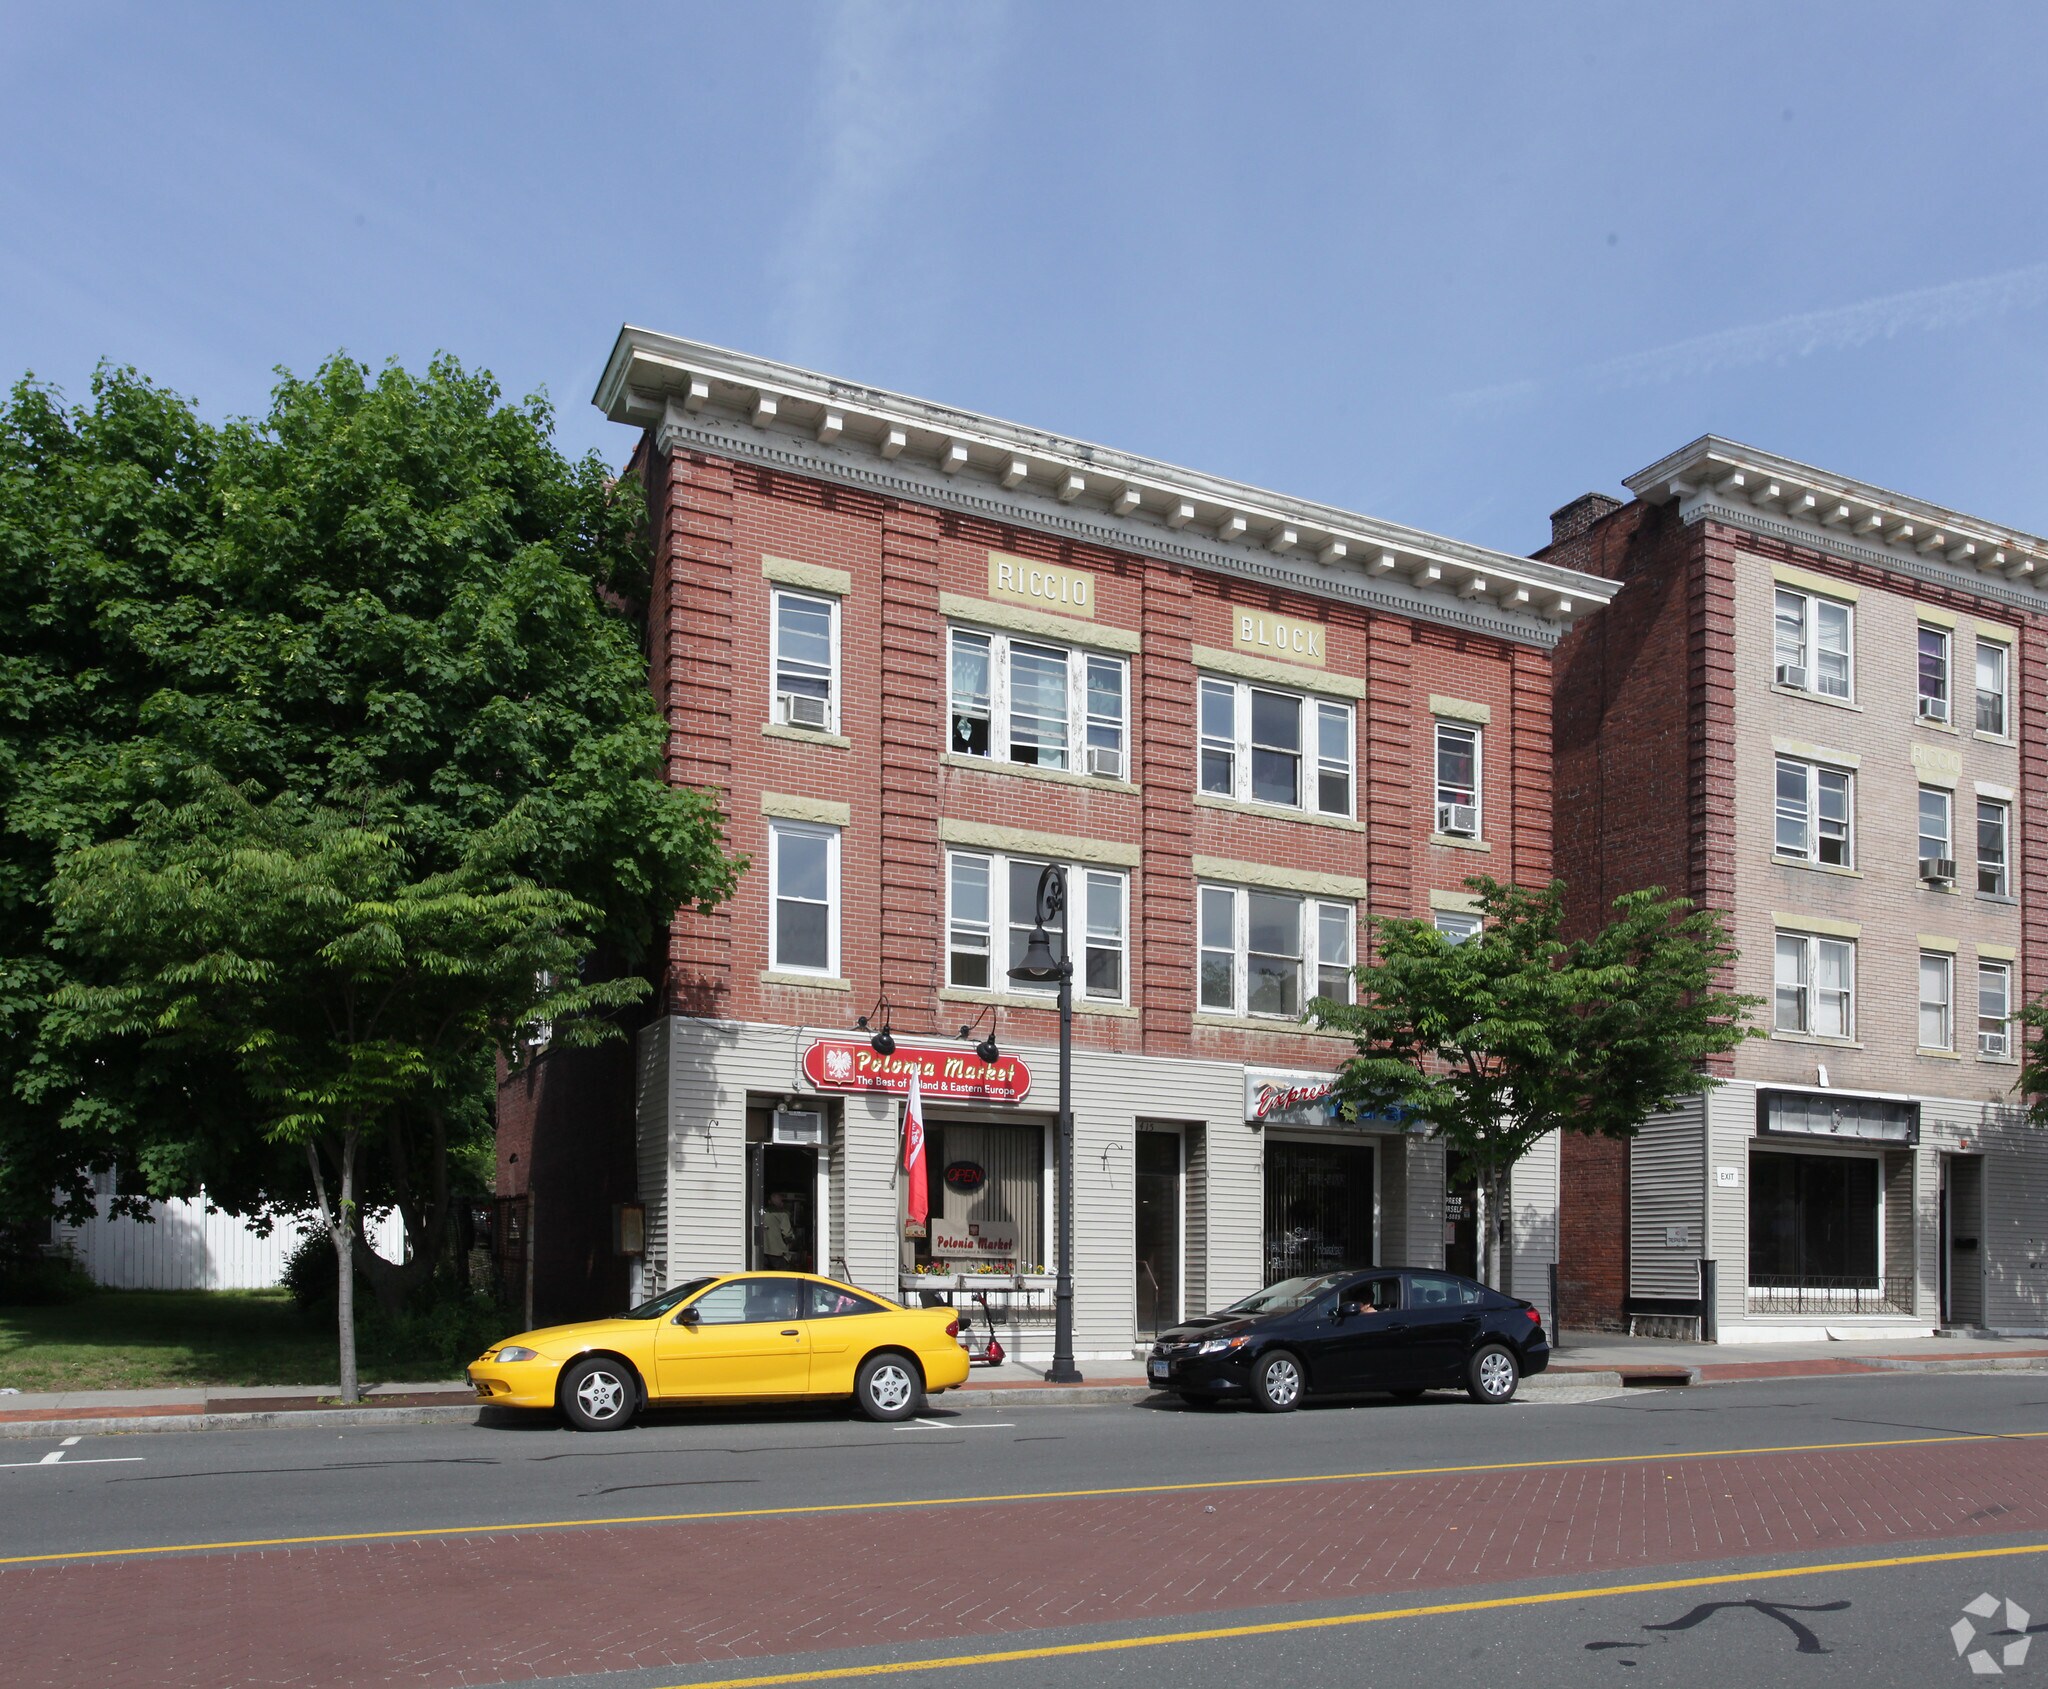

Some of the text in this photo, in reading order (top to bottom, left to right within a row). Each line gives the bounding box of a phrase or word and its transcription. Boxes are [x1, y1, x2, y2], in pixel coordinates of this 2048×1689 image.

[997, 562, 1086, 606] RICCIO
[1241, 615, 1320, 657] BLOCK
[1913, 745, 1960, 773] RICCIO
[856, 1051, 1015, 1082] Polonia Market
[856, 1075, 873, 1085] The
[876, 1077, 896, 1087] Best
[897, 1078, 907, 1088] of
[941, 1081, 948, 1091] &
[950, 1082, 982, 1093] Eastern
[984, 1084, 1015, 1097] Europe
[947, 1168, 983, 1182] OPEN
[1720, 1172, 1734, 1180] EXIT
[937, 1236, 1013, 1250] Polonia Market
